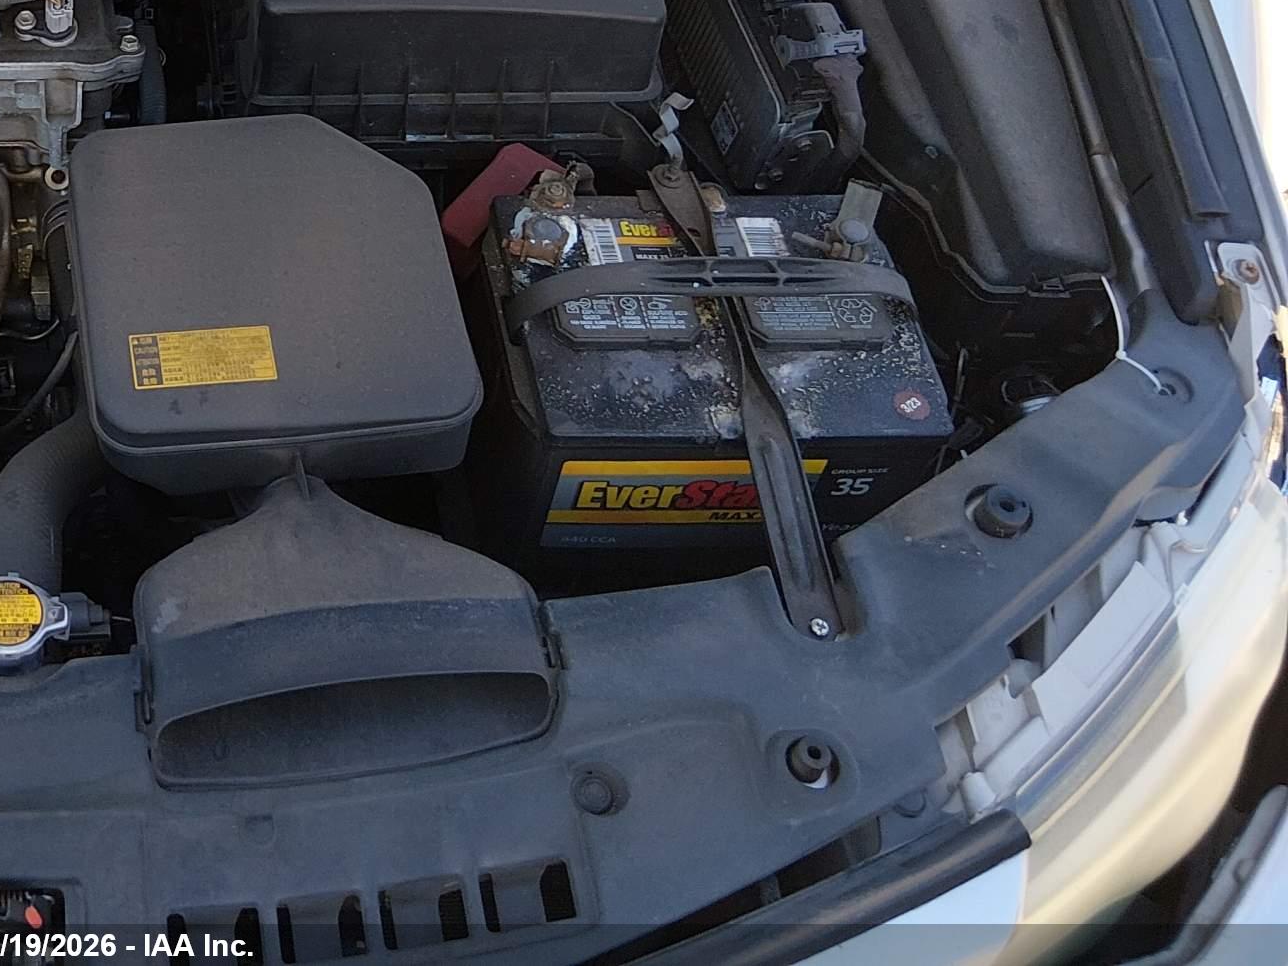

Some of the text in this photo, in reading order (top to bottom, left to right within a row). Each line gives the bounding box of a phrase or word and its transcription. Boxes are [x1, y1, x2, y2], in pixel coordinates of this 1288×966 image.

[575, 480, 761, 509] EverSta
[830, 477, 875, 496] 35
[707, 511, 761, 521] MAX
